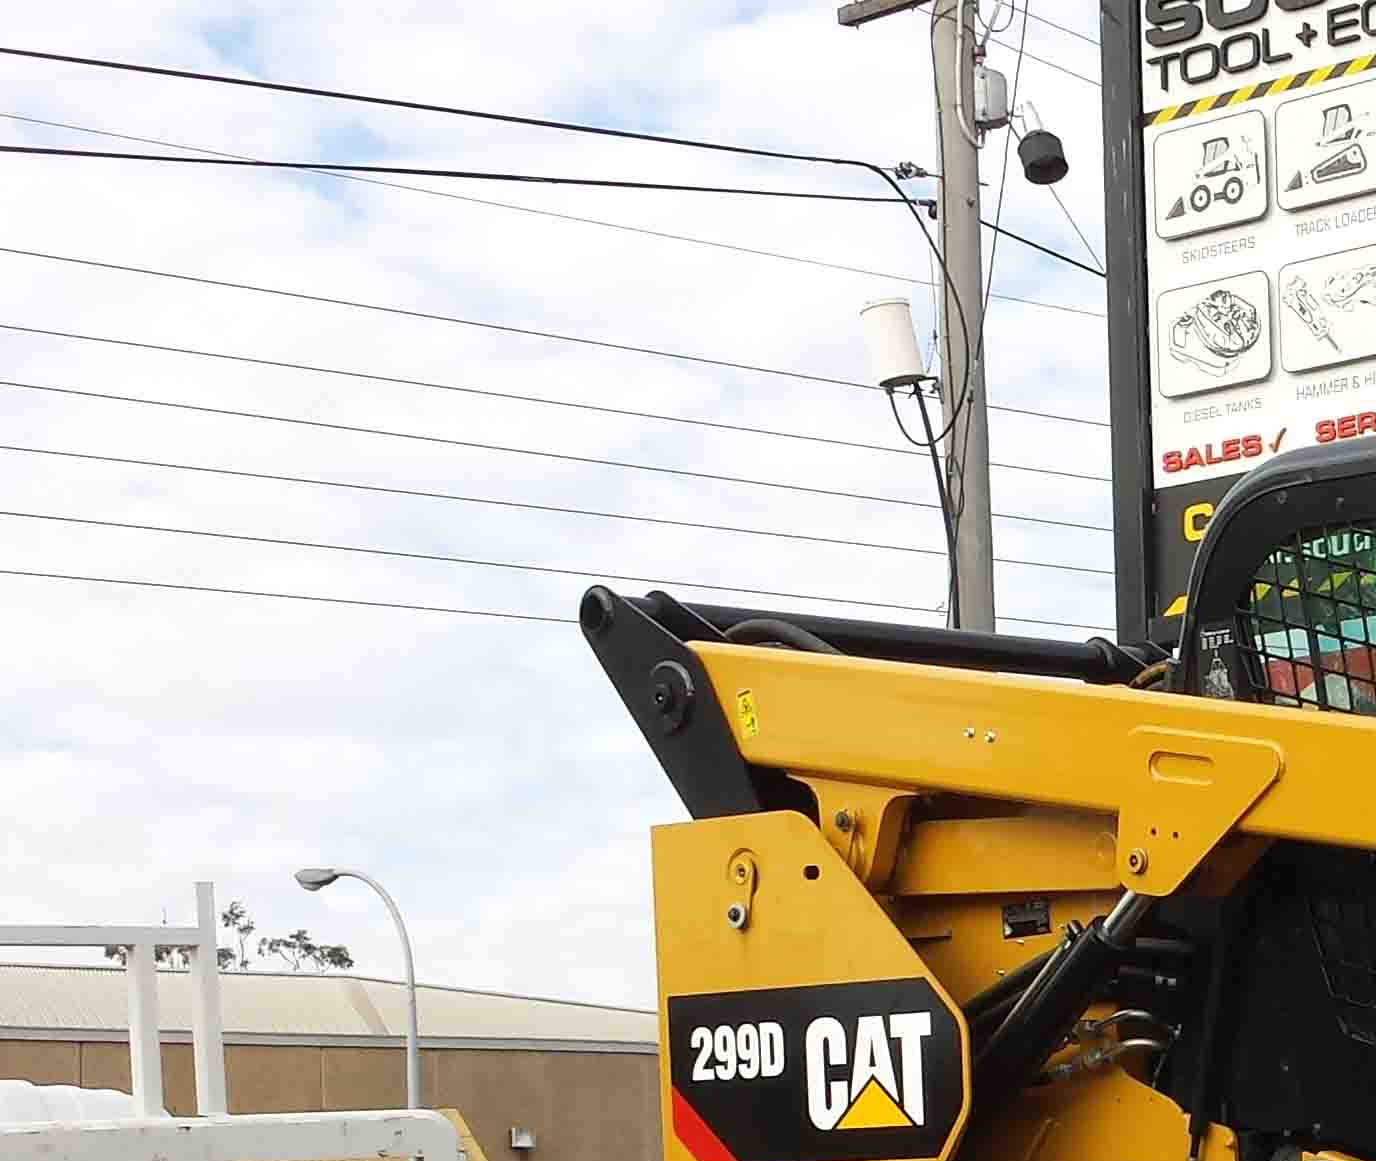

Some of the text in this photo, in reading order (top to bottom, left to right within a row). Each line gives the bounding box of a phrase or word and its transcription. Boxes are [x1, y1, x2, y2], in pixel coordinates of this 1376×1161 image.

[1146, 28, 1293, 92] TOOL
[1295, 217, 1331, 237] TRACK
[1182, 236, 1256, 264] SKIDSTEERS
[1296, 379, 1349, 401] HAMMER
[1352, 375, 1361, 389] &
[1183, 397, 1262, 424] DIESEL TANKS
[1162, 435, 1263, 474] SALES
[690, 1011, 932, 1131] 299D CAT
